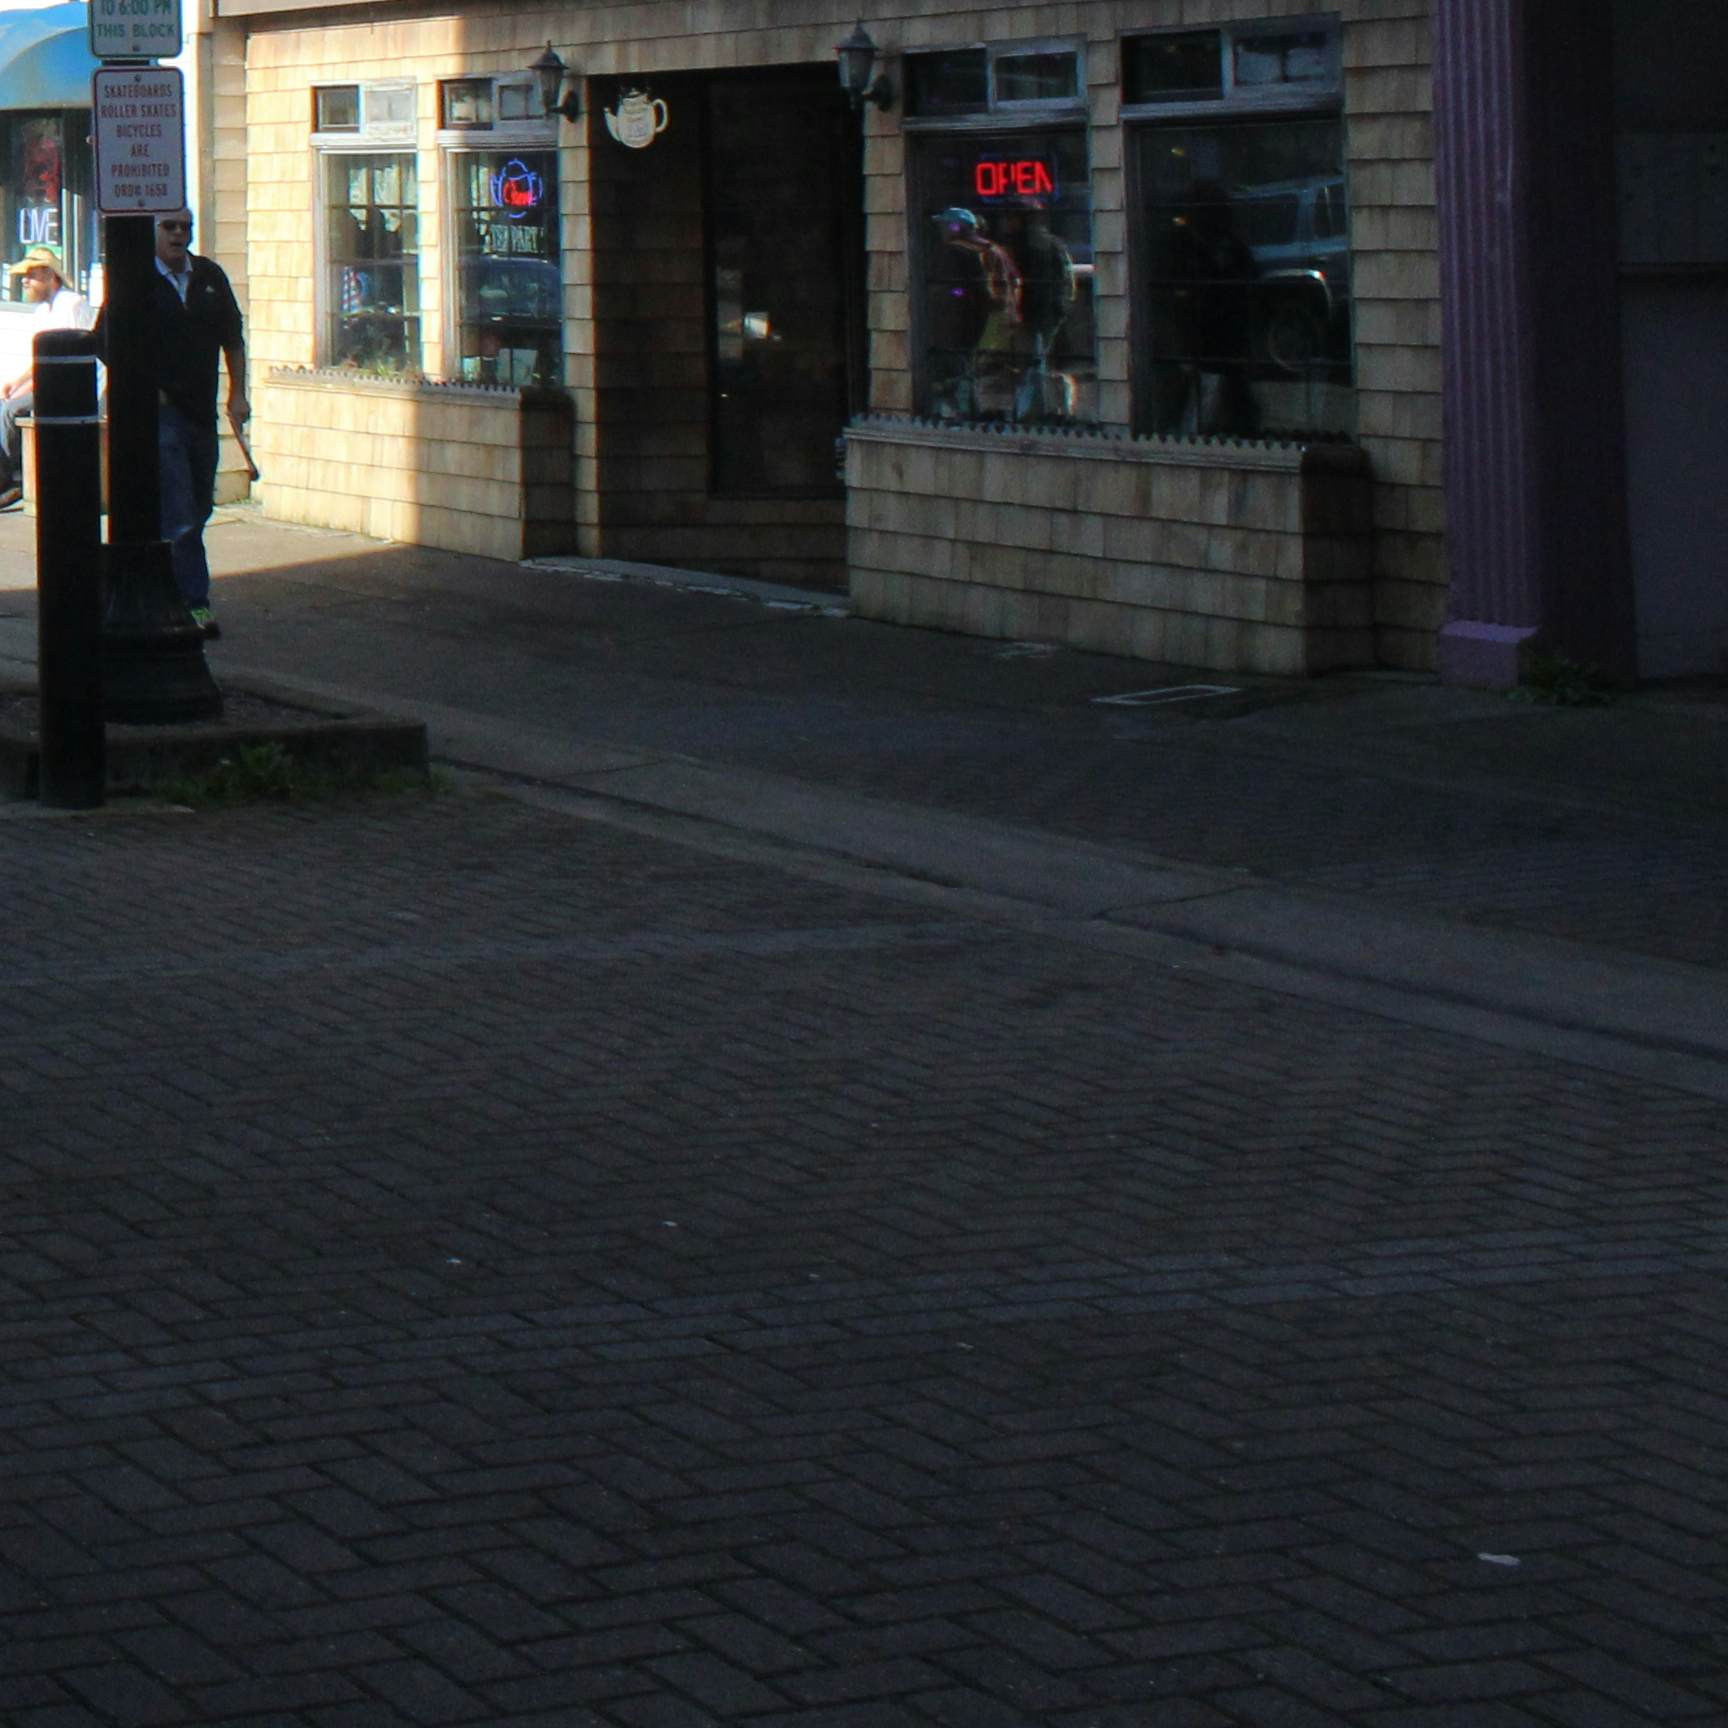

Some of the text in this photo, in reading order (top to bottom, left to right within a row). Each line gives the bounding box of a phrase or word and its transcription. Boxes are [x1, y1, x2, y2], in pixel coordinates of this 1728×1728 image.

[154, 0, 171, 15] PM
[97, 23, 175, 38] THIS BLOCK
[104, 85, 172, 99] SKATEBOARDS
[101, 103, 176, 118] ROLLER SKATES
[116, 124, 161, 138] BICYCLES
[130, 144, 150, 157] ARE
[111, 164, 170, 177] PROHIBITED
[976, 161, 1053, 195] OPEN
[19, 208, 58, 244] LIVE
